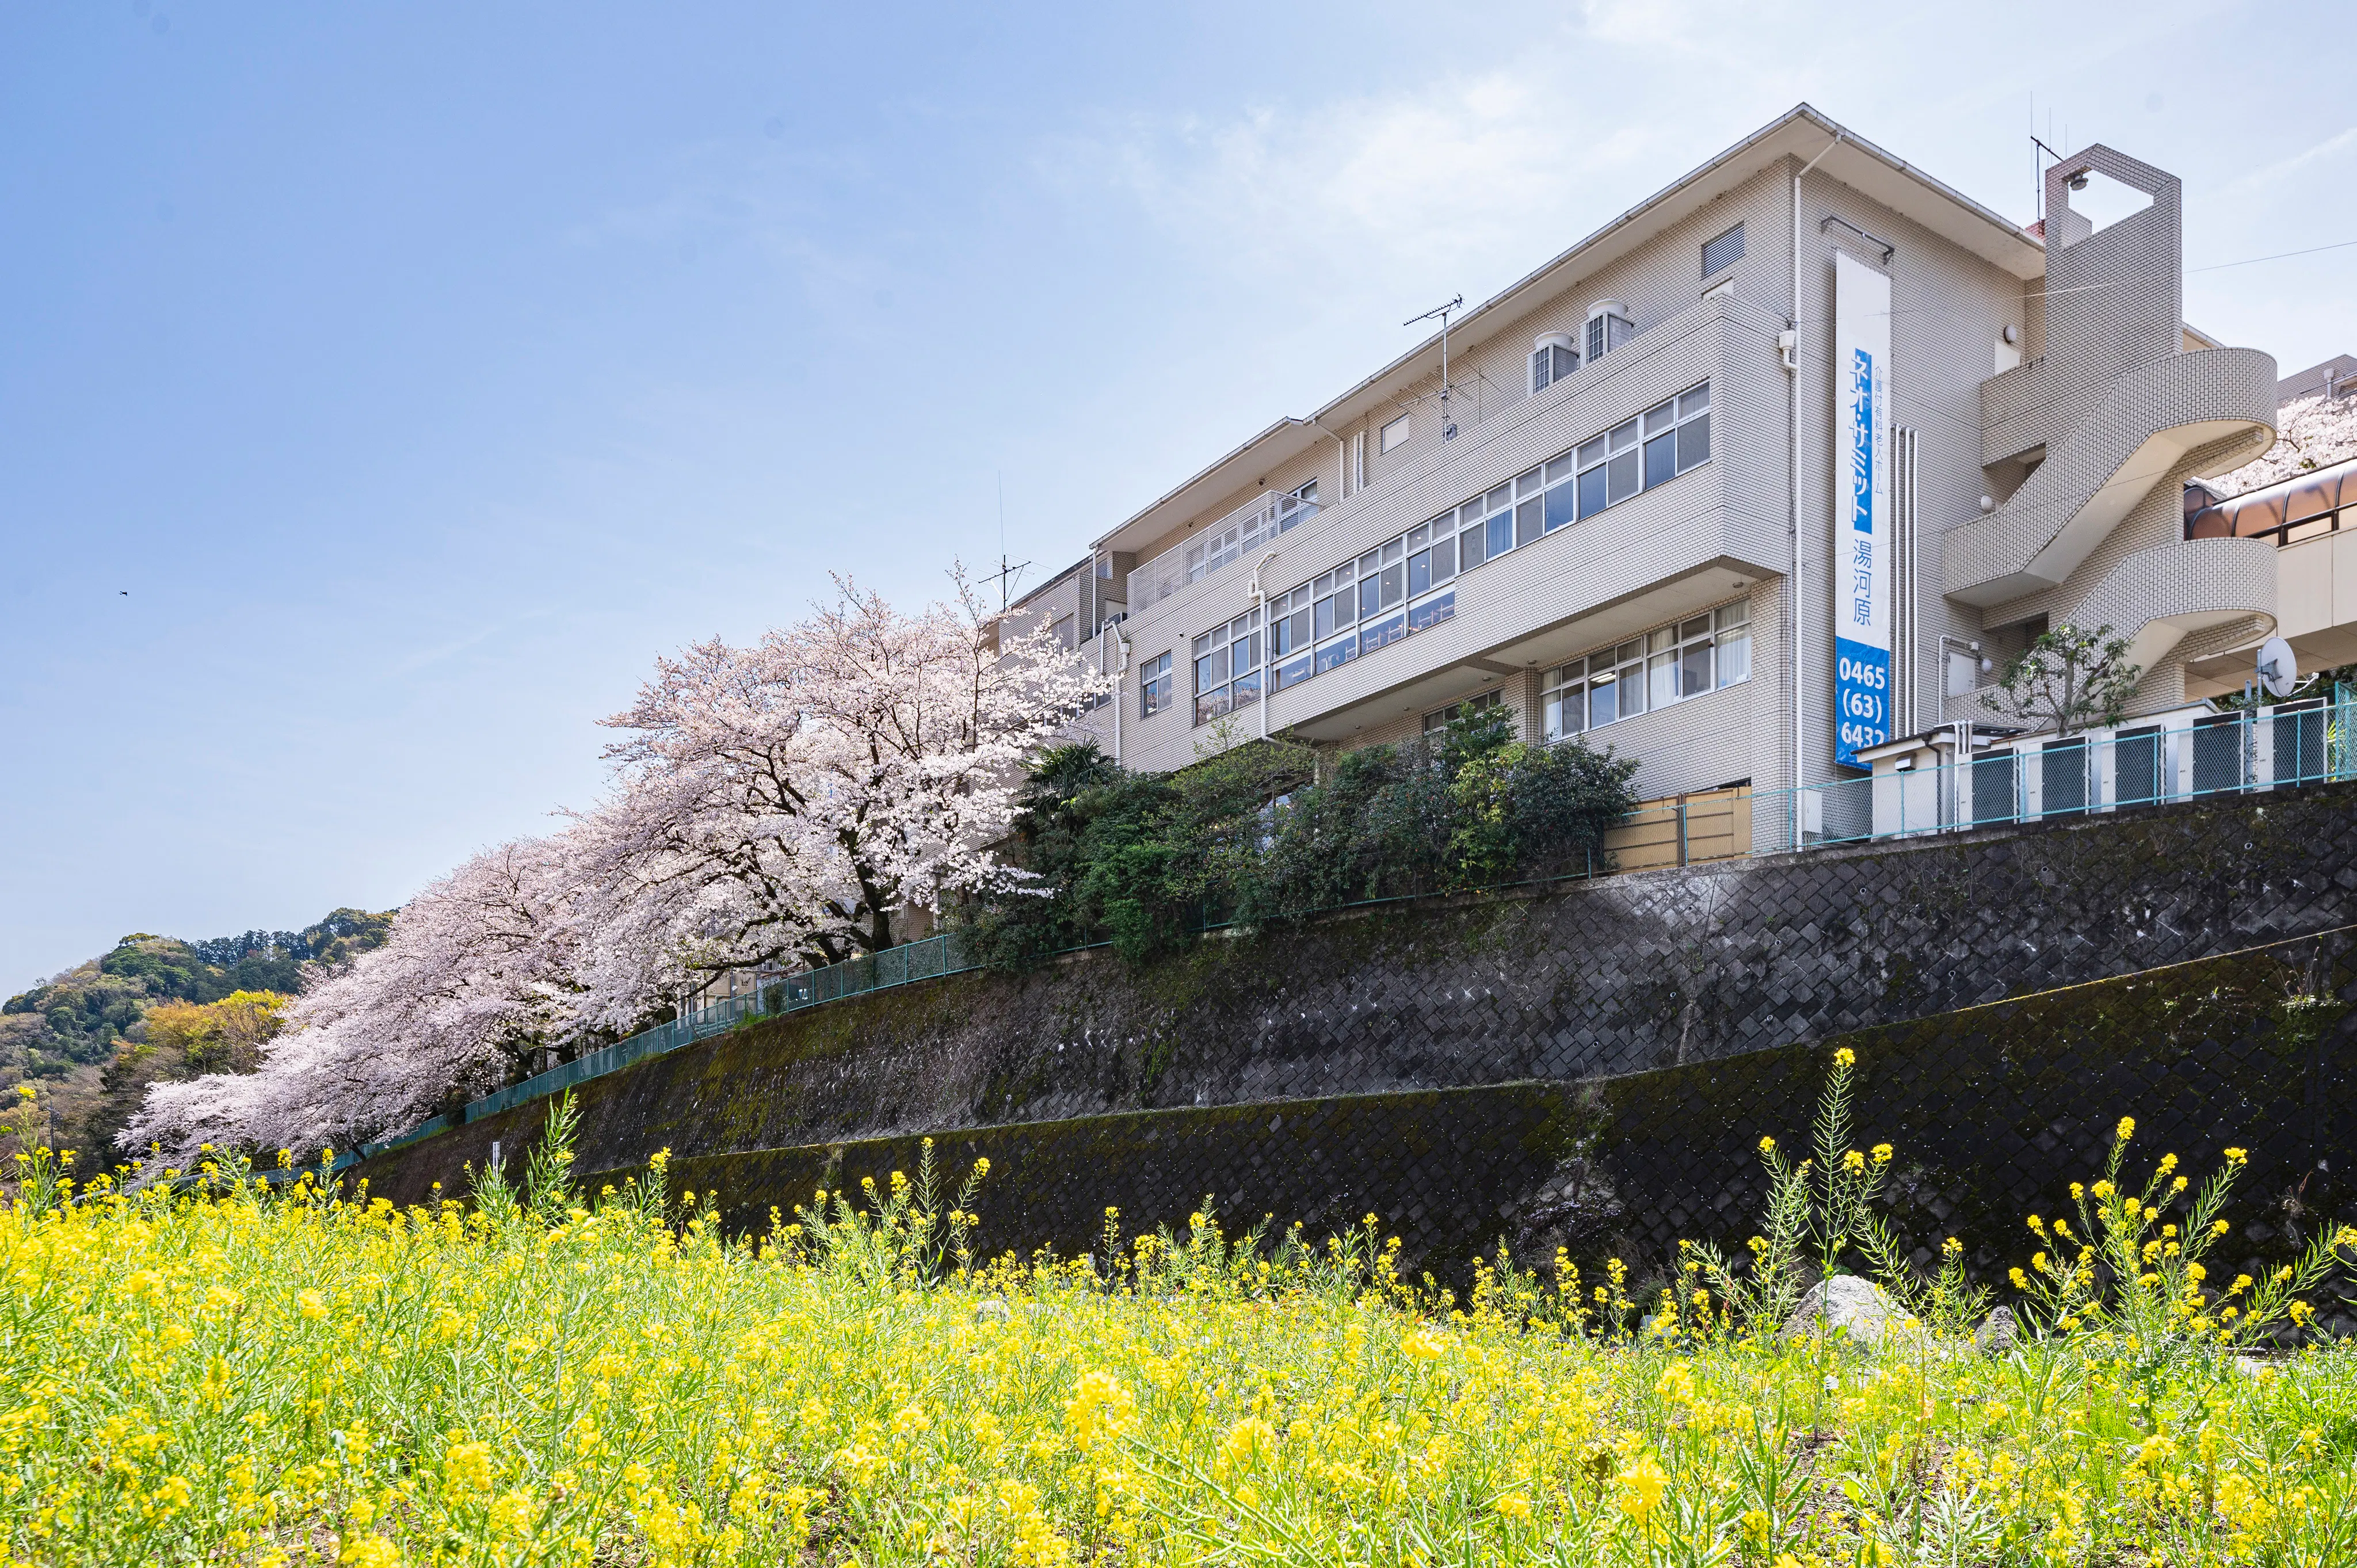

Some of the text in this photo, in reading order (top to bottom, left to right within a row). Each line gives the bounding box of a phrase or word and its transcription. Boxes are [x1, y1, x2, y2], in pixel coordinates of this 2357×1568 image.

[1874, 366, 1883, 495] 介護付有料老人ホーム
[1853, 539, 1872, 626] 湯河原
[1839, 657, 1885, 689] 0465
[1843, 689, 1882, 723] (63)
